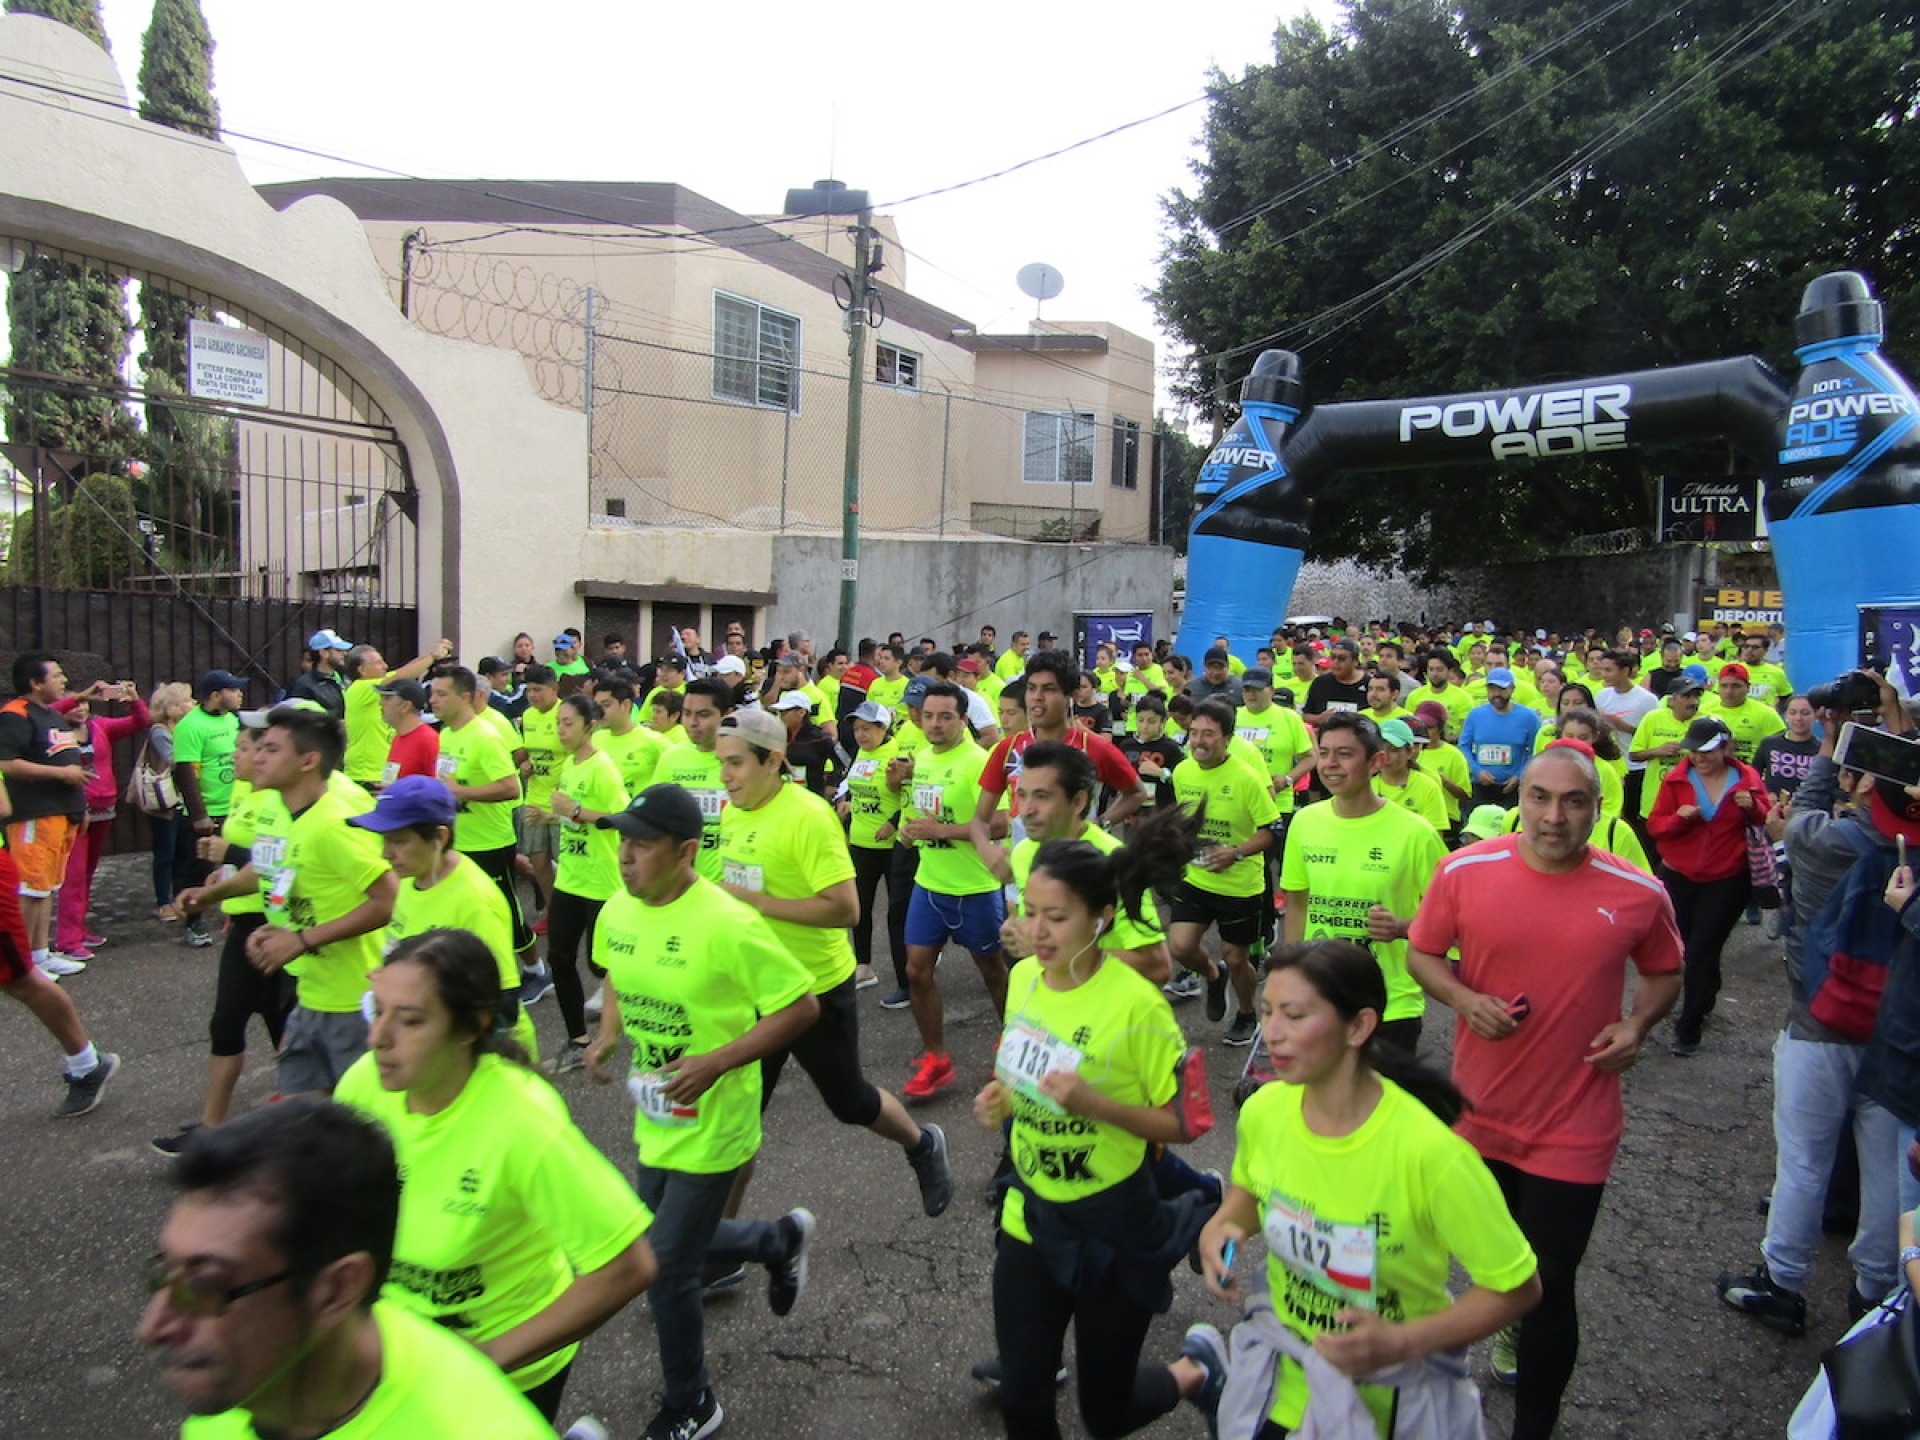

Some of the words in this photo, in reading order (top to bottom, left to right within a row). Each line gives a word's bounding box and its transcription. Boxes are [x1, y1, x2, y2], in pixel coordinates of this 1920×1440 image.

[1400, 384, 1631, 443] POWER
[1788, 393, 1911, 426] POWER
[1490, 421, 1628, 461] ADE
[1785, 416, 1858, 447] ADE
[1208, 447, 1277, 471] OWER
[1671, 496, 1750, 513] ULTRA
[703, 833, 720, 850] 5
[1038, 1145, 1100, 1181] 5K
